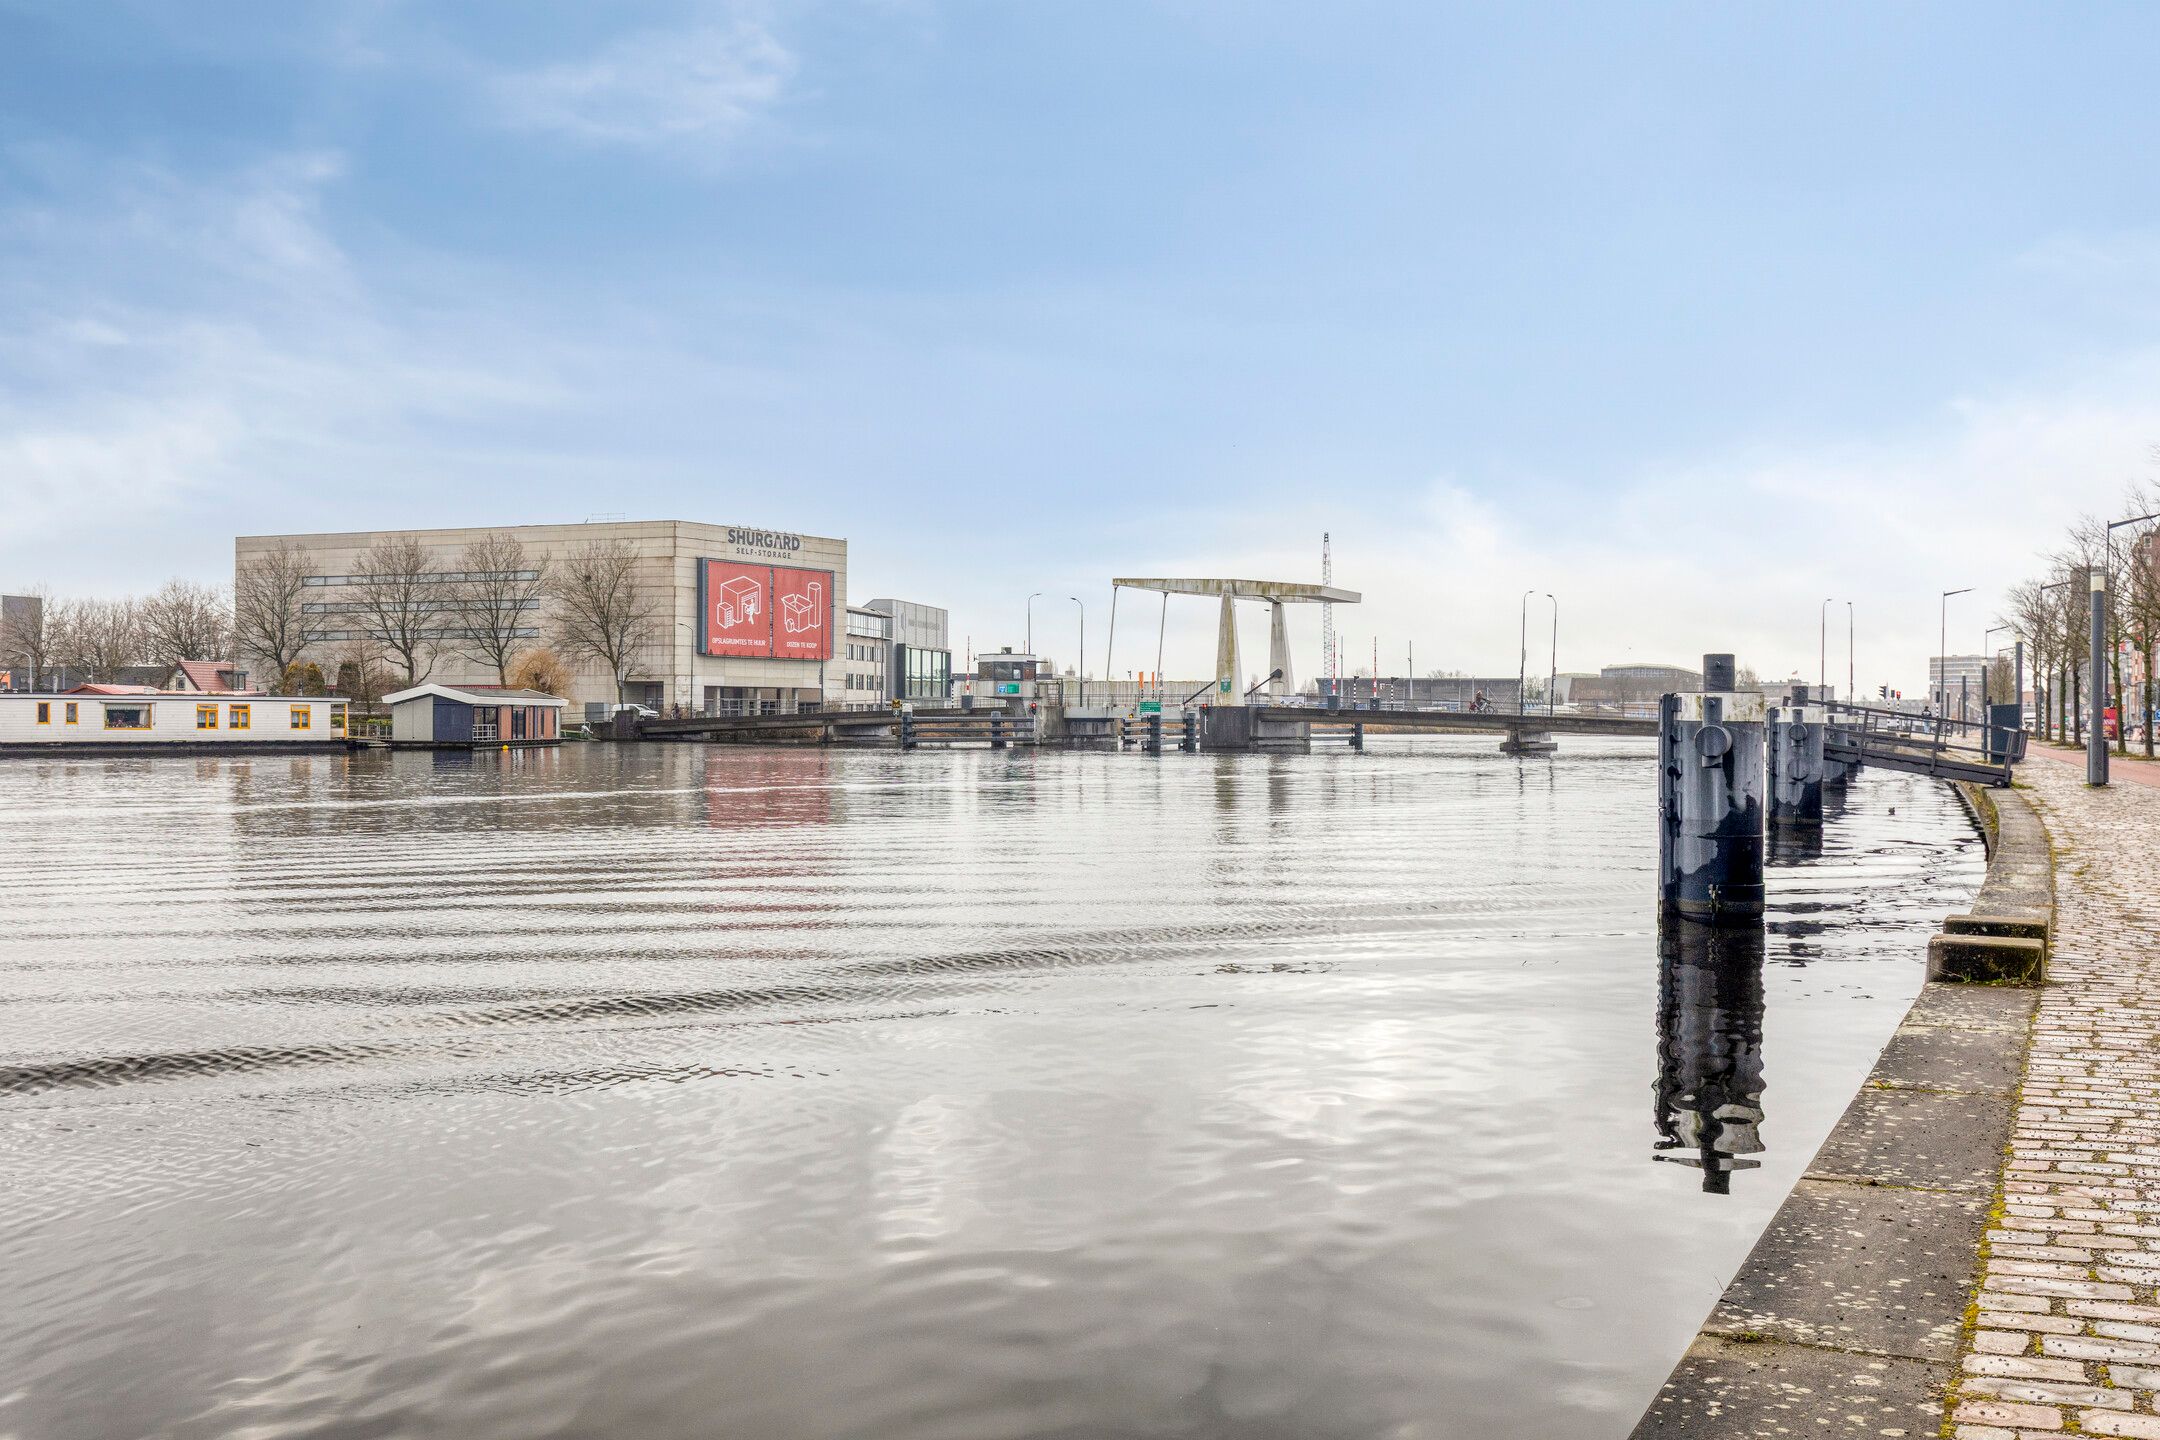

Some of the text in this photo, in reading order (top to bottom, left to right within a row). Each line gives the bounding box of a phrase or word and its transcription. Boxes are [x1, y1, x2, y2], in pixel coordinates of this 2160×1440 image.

[728, 529, 801, 551] SHURGARD
[736, 547, 792, 560] SELF-STORAGE
[712, 638, 747, 646] OPSLAGRUIMTES
